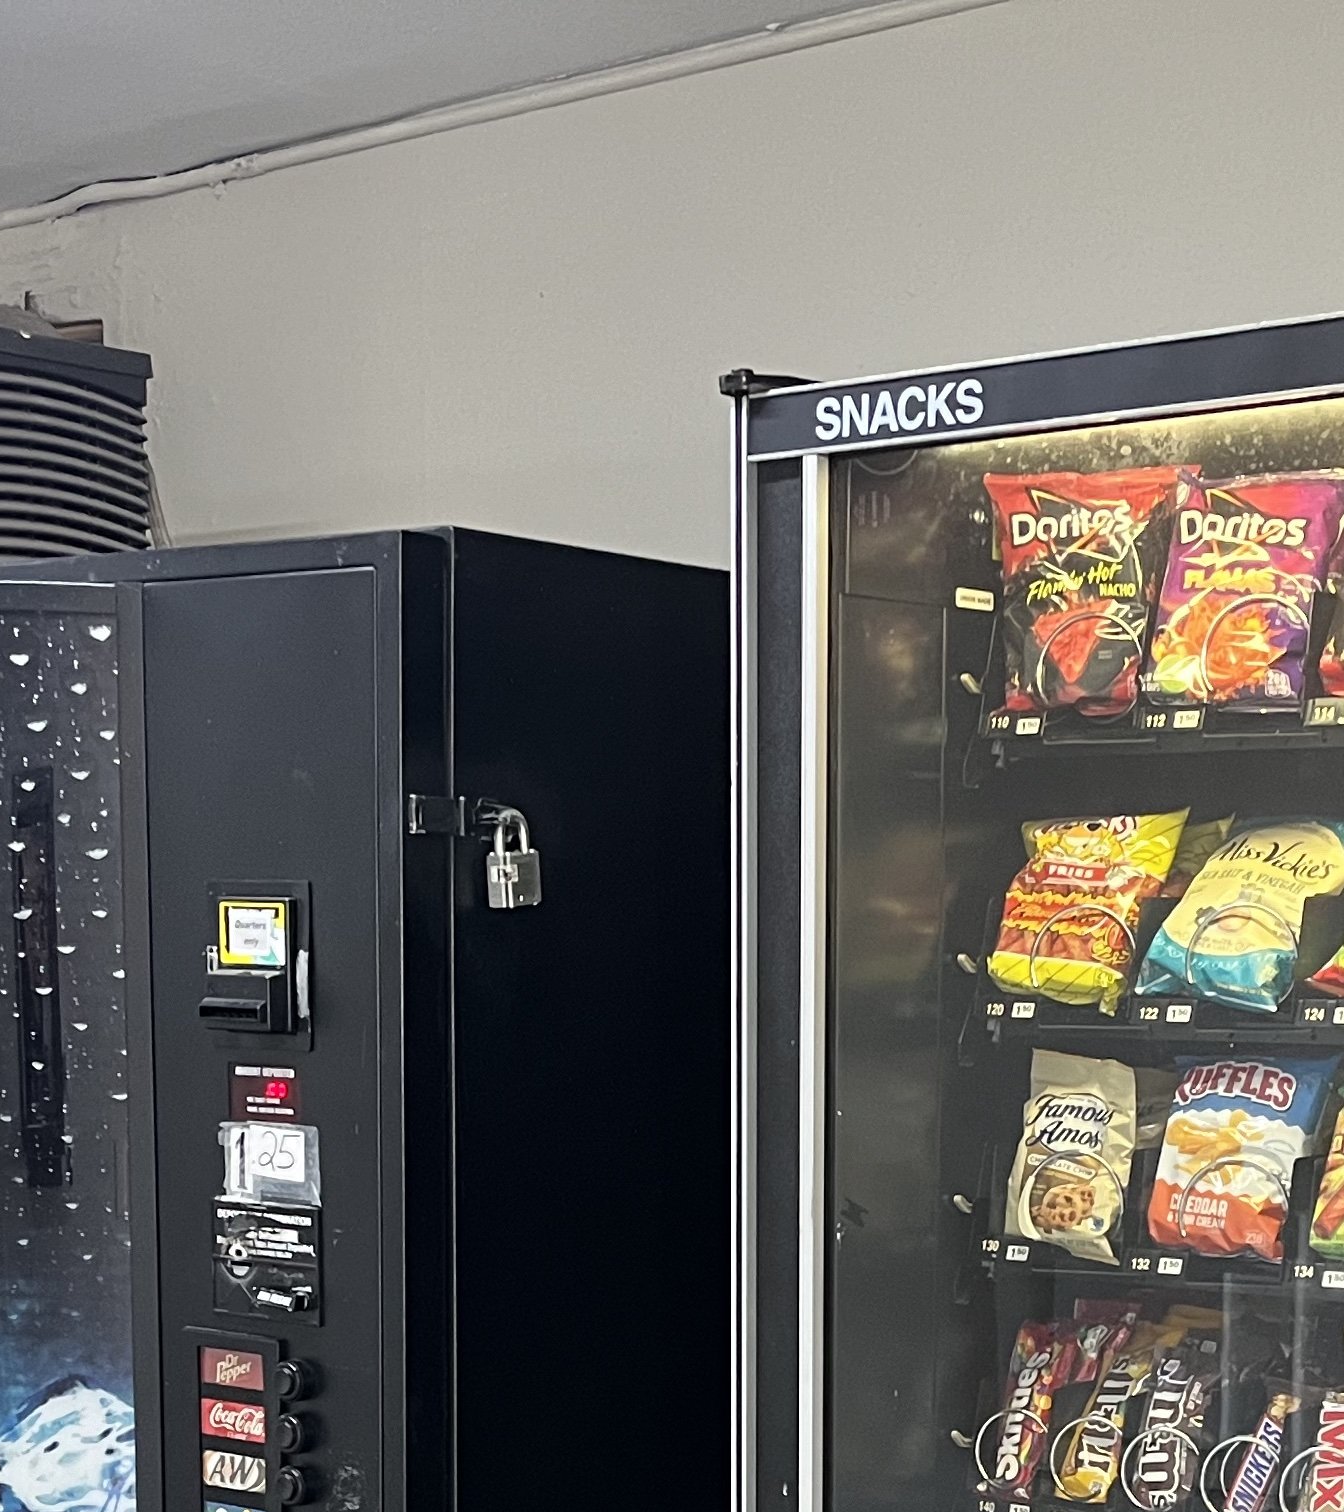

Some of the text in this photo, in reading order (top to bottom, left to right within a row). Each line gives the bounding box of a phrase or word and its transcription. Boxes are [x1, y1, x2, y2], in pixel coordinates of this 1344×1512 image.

[815, 379, 984, 441] SNACKS
[1012, 506, 1133, 546] Doritos
[1180, 510, 1307, 546] Doritos
[1088, 562, 1122, 584] Hot
[1100, 583, 1136, 598] NACHO
[990, 715, 1010, 730] 110
[1145, 713, 1167, 729] 112
[1264, 841, 1340, 885] Vickie's
[1047, 864, 1095, 879] FRIES
[234, 919, 267, 931] Quarters
[986, 1002, 1005, 1016] 120
[1139, 1006, 1159, 1021] 122
[1304, 1007, 1326, 1022] 124
[1026, 1094, 1115, 1126] Famous
[1026, 1120, 1101, 1148] Amos
[258, 1130, 302, 1171] 25
[1029, 1155, 1072, 1173] CHOLATE
[981, 1239, 1000, 1253] 130
[1130, 1257, 1151, 1271] 132
[1292, 1265, 1315, 1279] 134
[225, 1354, 239, 1366] Dr
[216, 1360, 252, 1384] Pepper
[209, 1455, 256, 1486] AW
